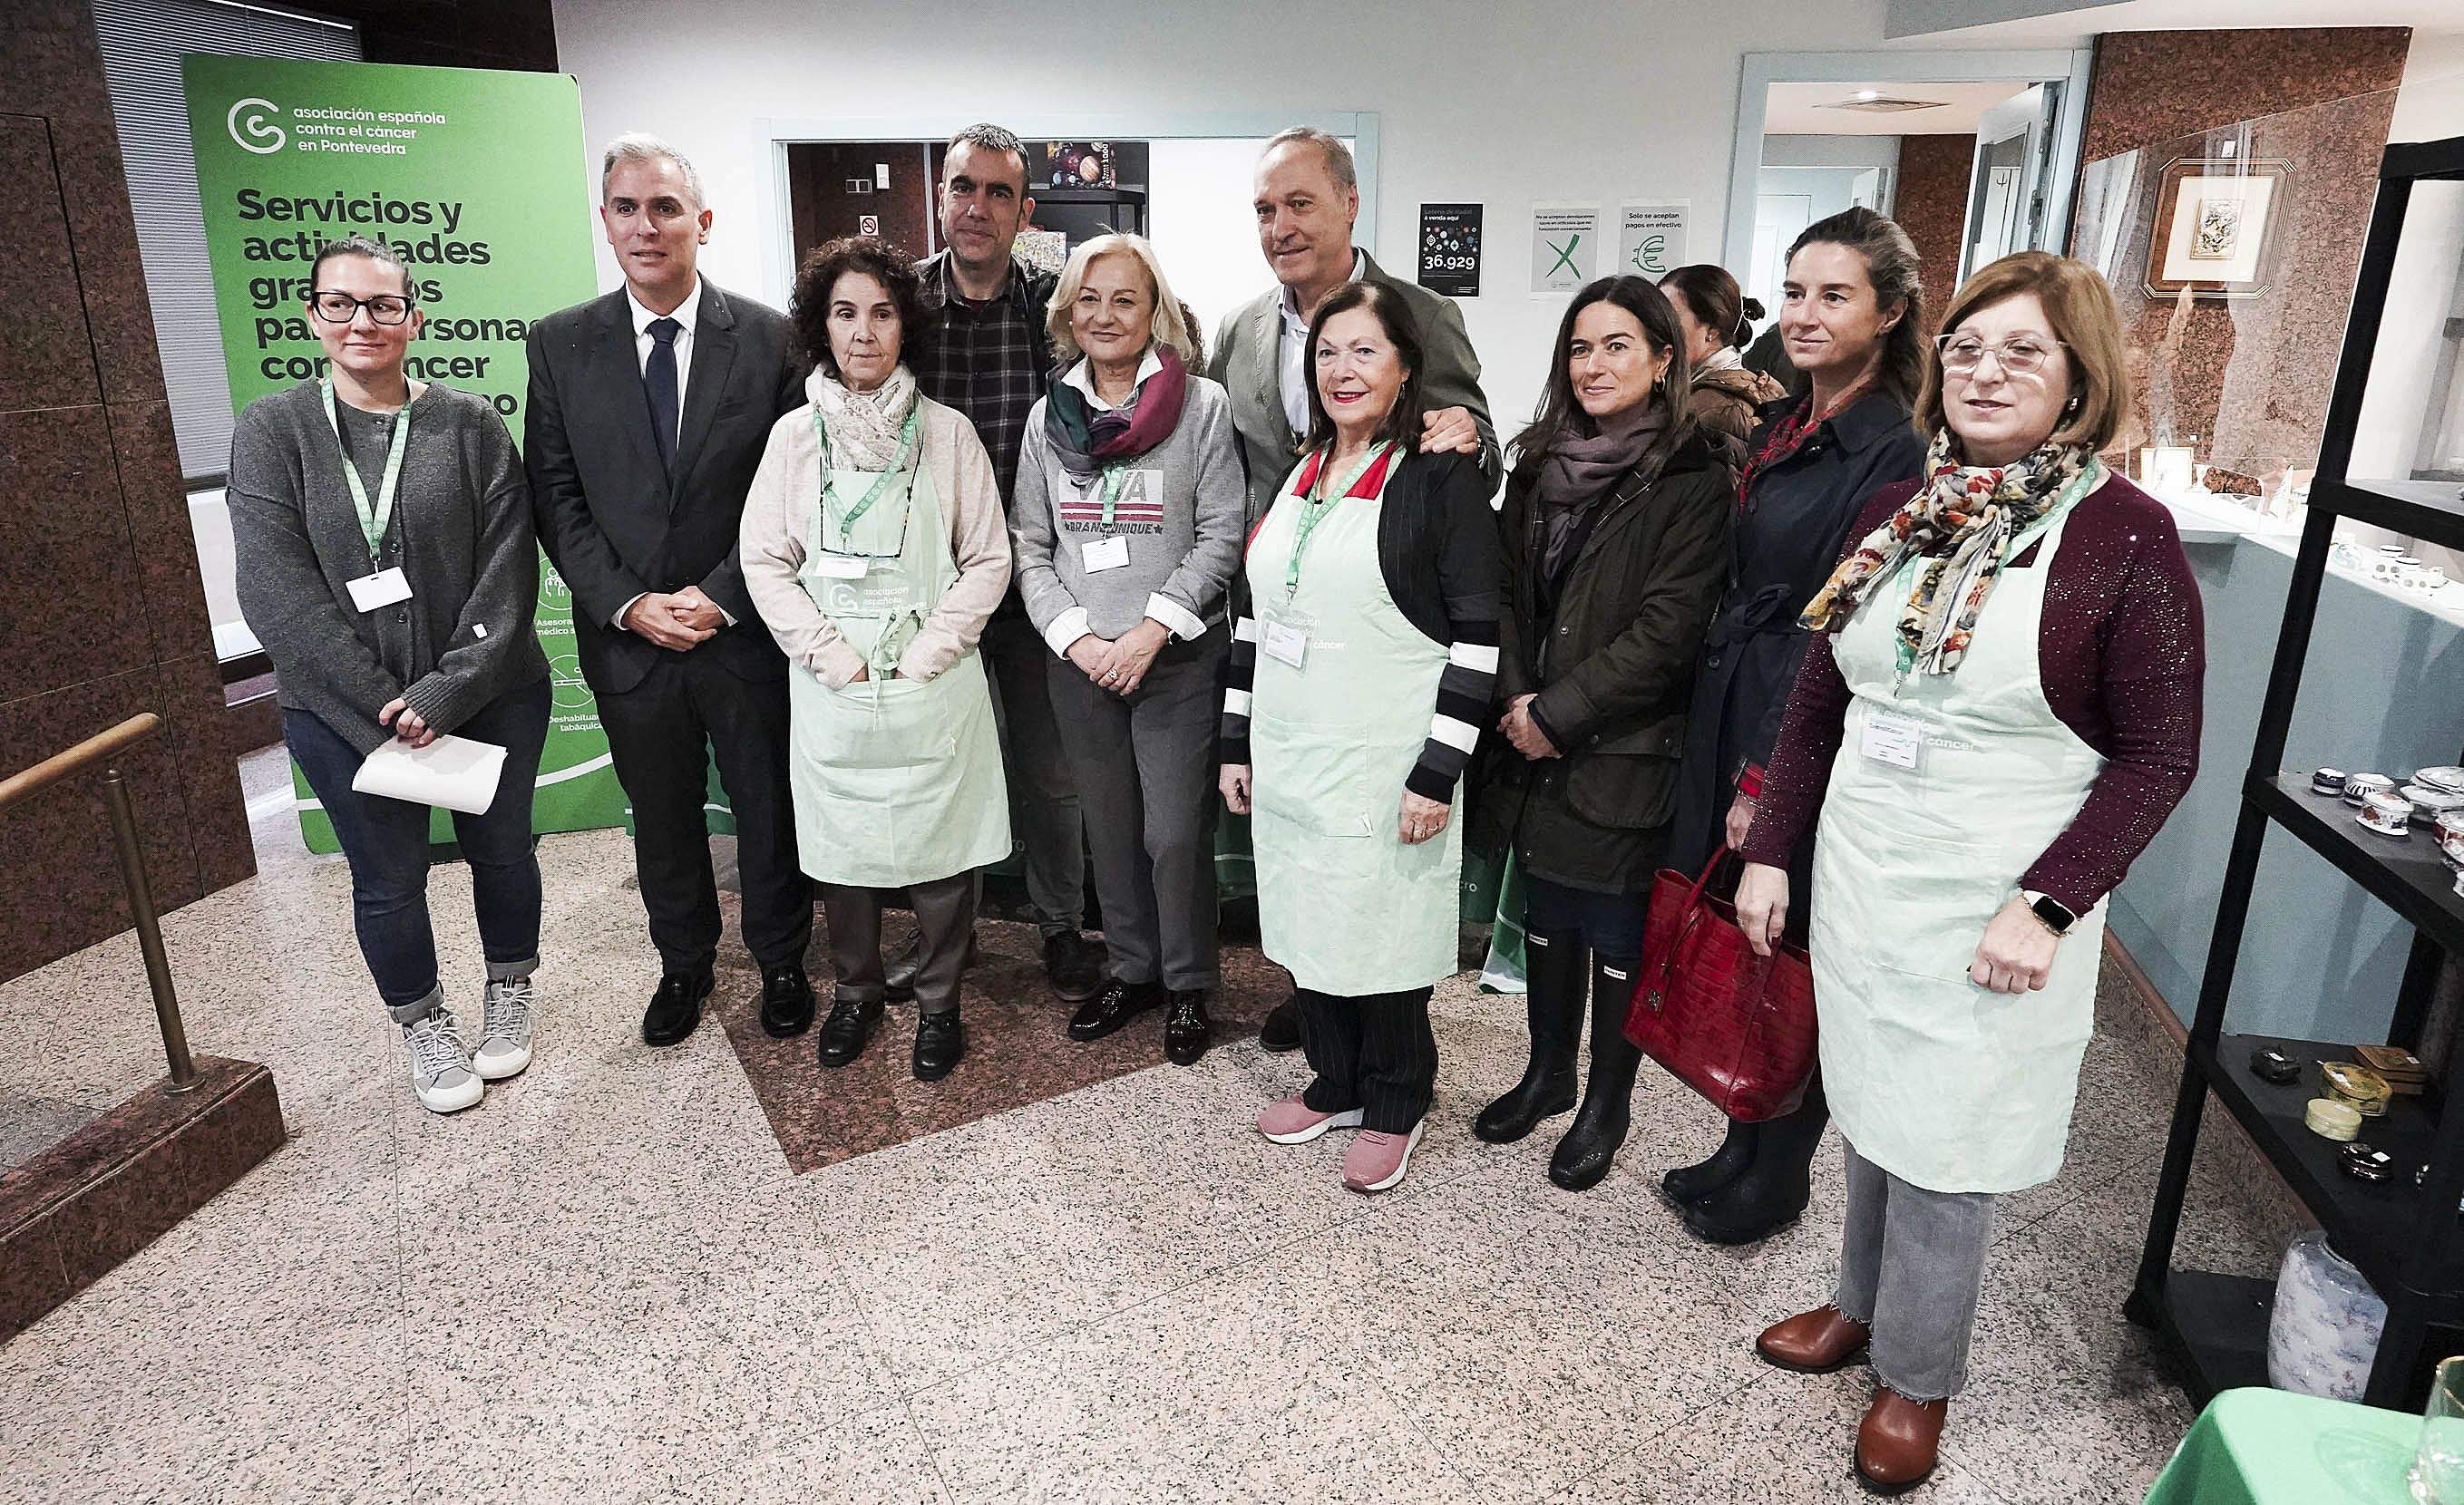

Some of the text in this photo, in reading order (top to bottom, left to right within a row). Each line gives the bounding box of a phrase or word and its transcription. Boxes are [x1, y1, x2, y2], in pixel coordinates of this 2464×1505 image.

[293, 106, 447, 126] asociación española
[296, 123, 417, 139] contra el cáncer
[297, 140, 406, 155] en Pontevedra
[237, 188, 463, 234] Servicios y
[243, 230, 491, 266] actiades
[1424, 254, 1475, 270] 36.929
[402, 356, 491, 379] ncer
